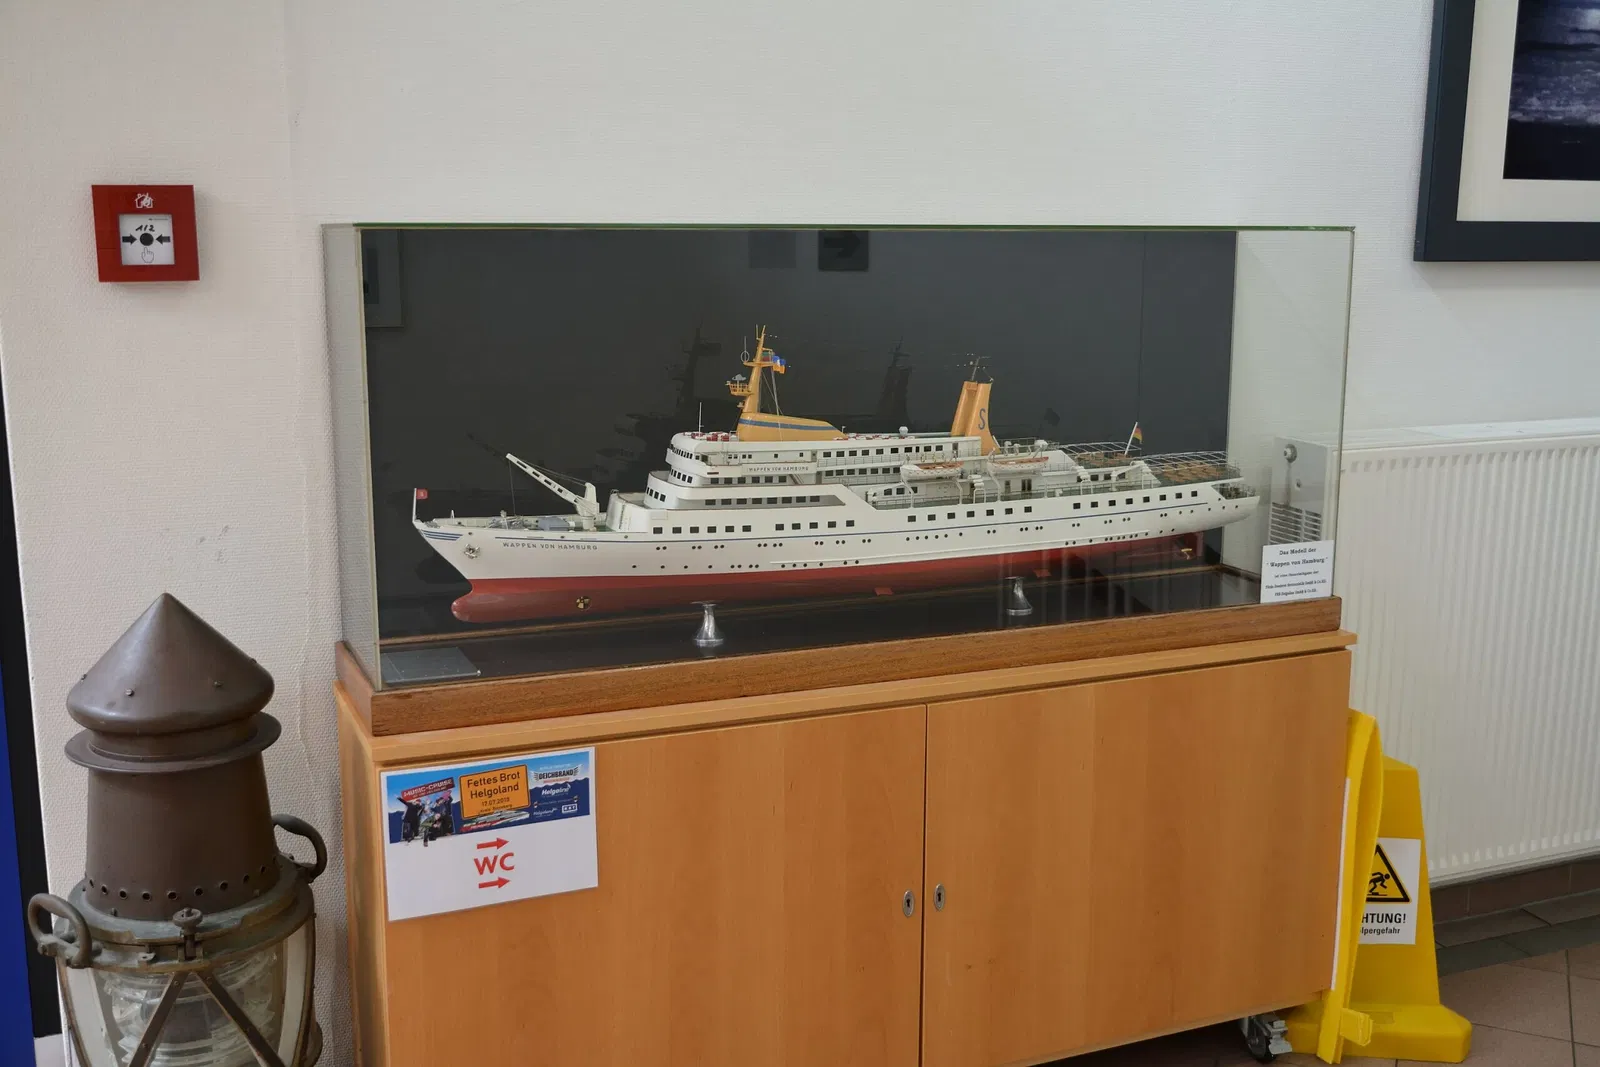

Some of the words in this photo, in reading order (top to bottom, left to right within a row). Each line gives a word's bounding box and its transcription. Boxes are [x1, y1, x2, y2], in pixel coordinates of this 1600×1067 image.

[978, 408, 986, 430] S
[467, 776, 498, 788] Fettes
[499, 771, 521, 782] Brot
[538, 769, 574, 780] DEICHBRAND
[403, 779, 452, 797] MUSIC-CRUISE
[470, 782, 519, 799] Helgoland
[474, 852, 515, 876] WC
[1361, 913, 1406, 924] HTUNG!
[1360, 927, 1401, 935] lpergefahr
